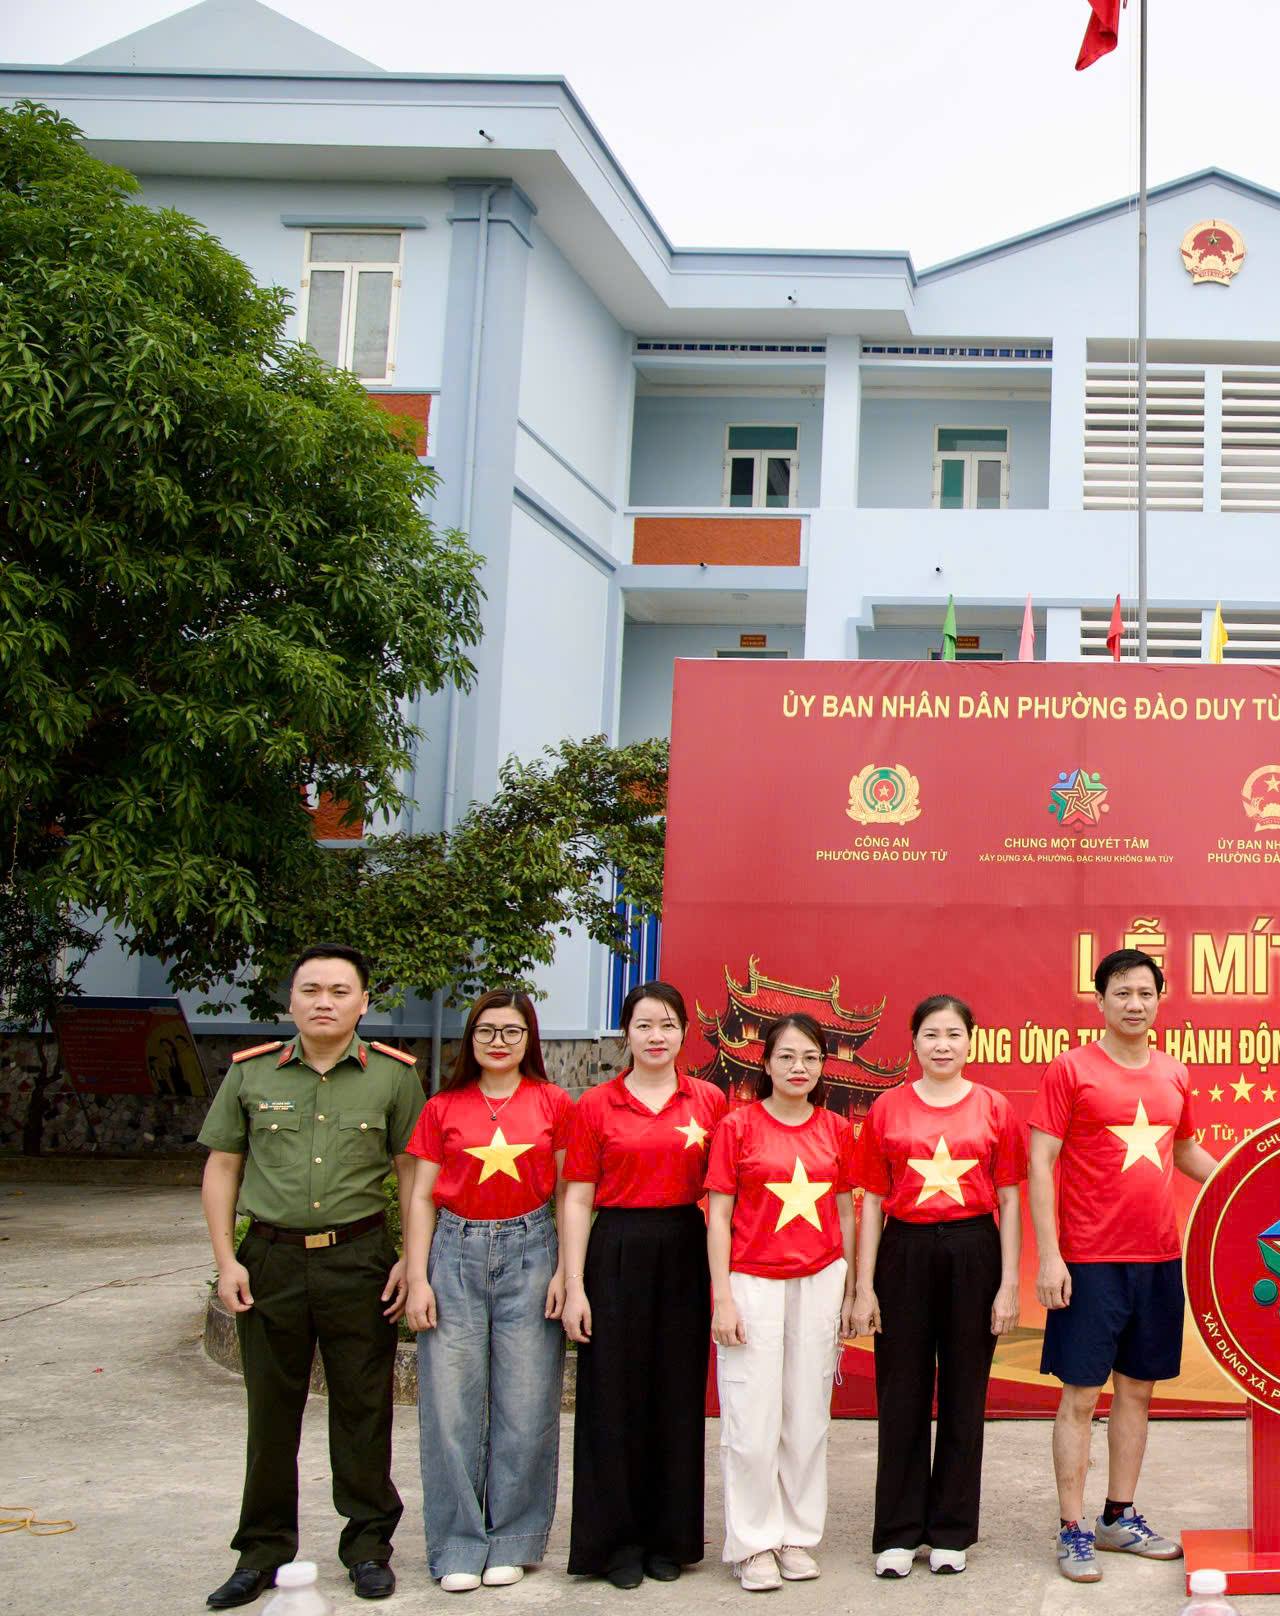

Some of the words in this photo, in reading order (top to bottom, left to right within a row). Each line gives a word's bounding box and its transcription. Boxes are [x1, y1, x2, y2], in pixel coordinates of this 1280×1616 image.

[783, 690, 816, 717] ỦY
[822, 696, 873, 718] BAN
[882, 691, 950, 718] NHÂN
[959, 691, 1010, 719] DÂN
[1018, 692, 1128, 719] PHƯỜNG
[1134, 693, 1188, 721] ĐÀO
[1196, 698, 1246, 721] DUY
[854, 835, 890, 847] CÔNG
[892, 837, 910, 847] AN
[1004, 838, 1047, 848] CHUNG
[1051, 837, 1075, 850] MỘT
[1080, 836, 1121, 849] QUYẾT
[1124, 837, 1149, 849] TÂM
[1217, 837, 1234, 850] ỦY
[1237, 839, 1262, 850] BAN
[816, 849, 870, 861] PHƯỜNG
[873, 849, 899, 861] ĐÀO
[902, 850, 928, 861] DUY
[979, 853, 996, 862] XÂY
[997, 854, 1021, 863] DỰNG
[1114, 854, 1142, 863] KHÔNG
[1145, 855, 1157, 863] MA
[1207, 852, 1261, 864] PHƯỜNG
[1019, 1020, 1070, 1064] ỨNG
[1165, 1021, 1232, 1065] HÀNH
[1202, 1311, 1222, 1339] XÂY
[1216, 1339, 1248, 1377] DỰNG
[1247, 1374, 1267, 1395] XÃ,
